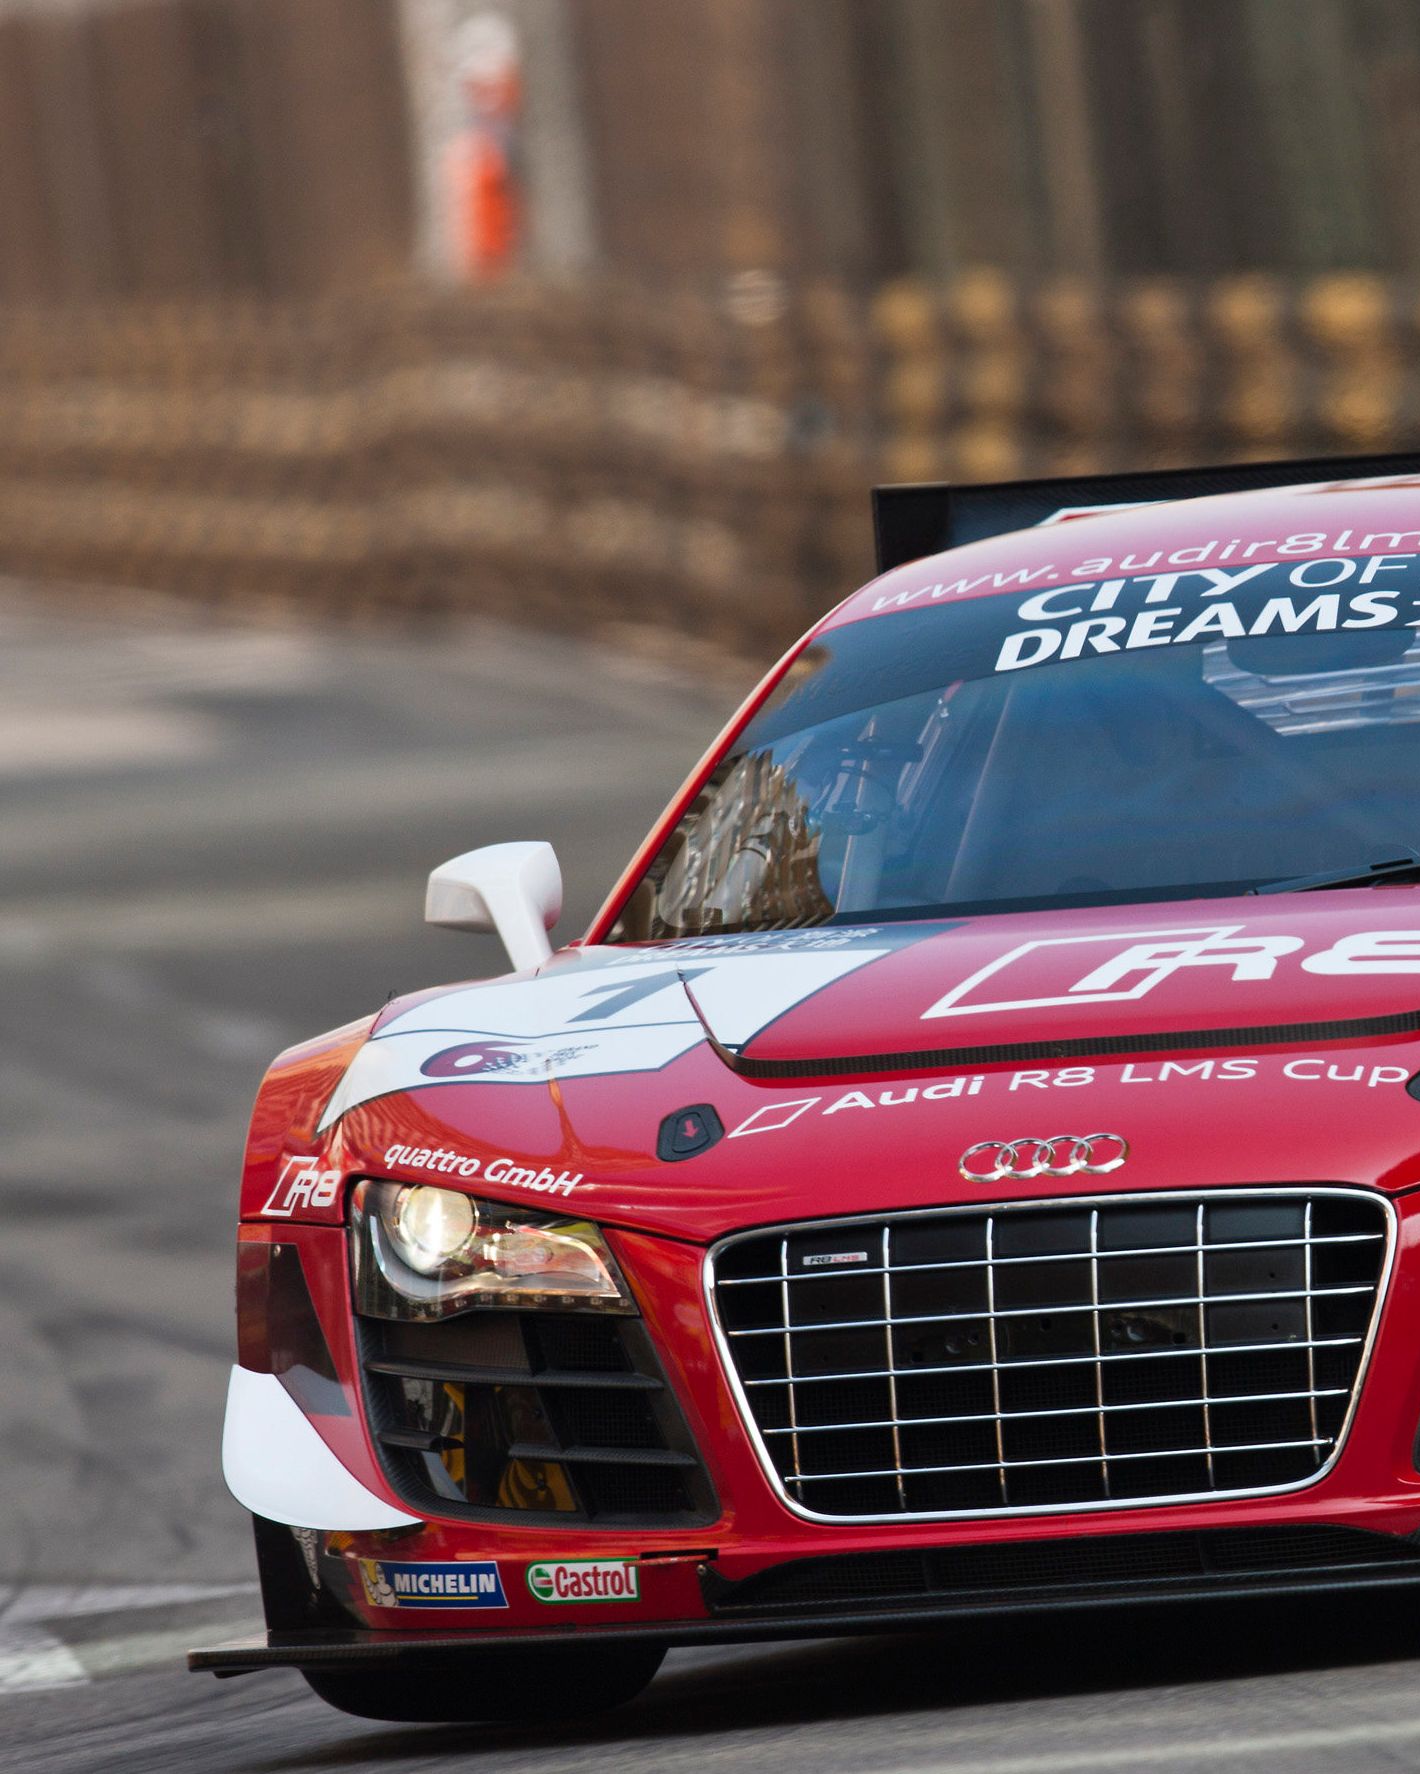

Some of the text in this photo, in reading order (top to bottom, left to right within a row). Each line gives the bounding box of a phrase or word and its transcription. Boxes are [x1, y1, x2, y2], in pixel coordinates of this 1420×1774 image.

[1018, 561, 1280, 621] CITY
[1289, 553, 1417, 588] OF
[994, 590, 1400, 672] DREAMS
[564, 966, 717, 1024] 1
[822, 1058, 1410, 1115] Audi R8 LMS Cup
[383, 1143, 584, 1198] quattro GmbH
[394, 1572, 497, 1594] MICHELIN
[554, 1565, 635, 1598] Castrol
